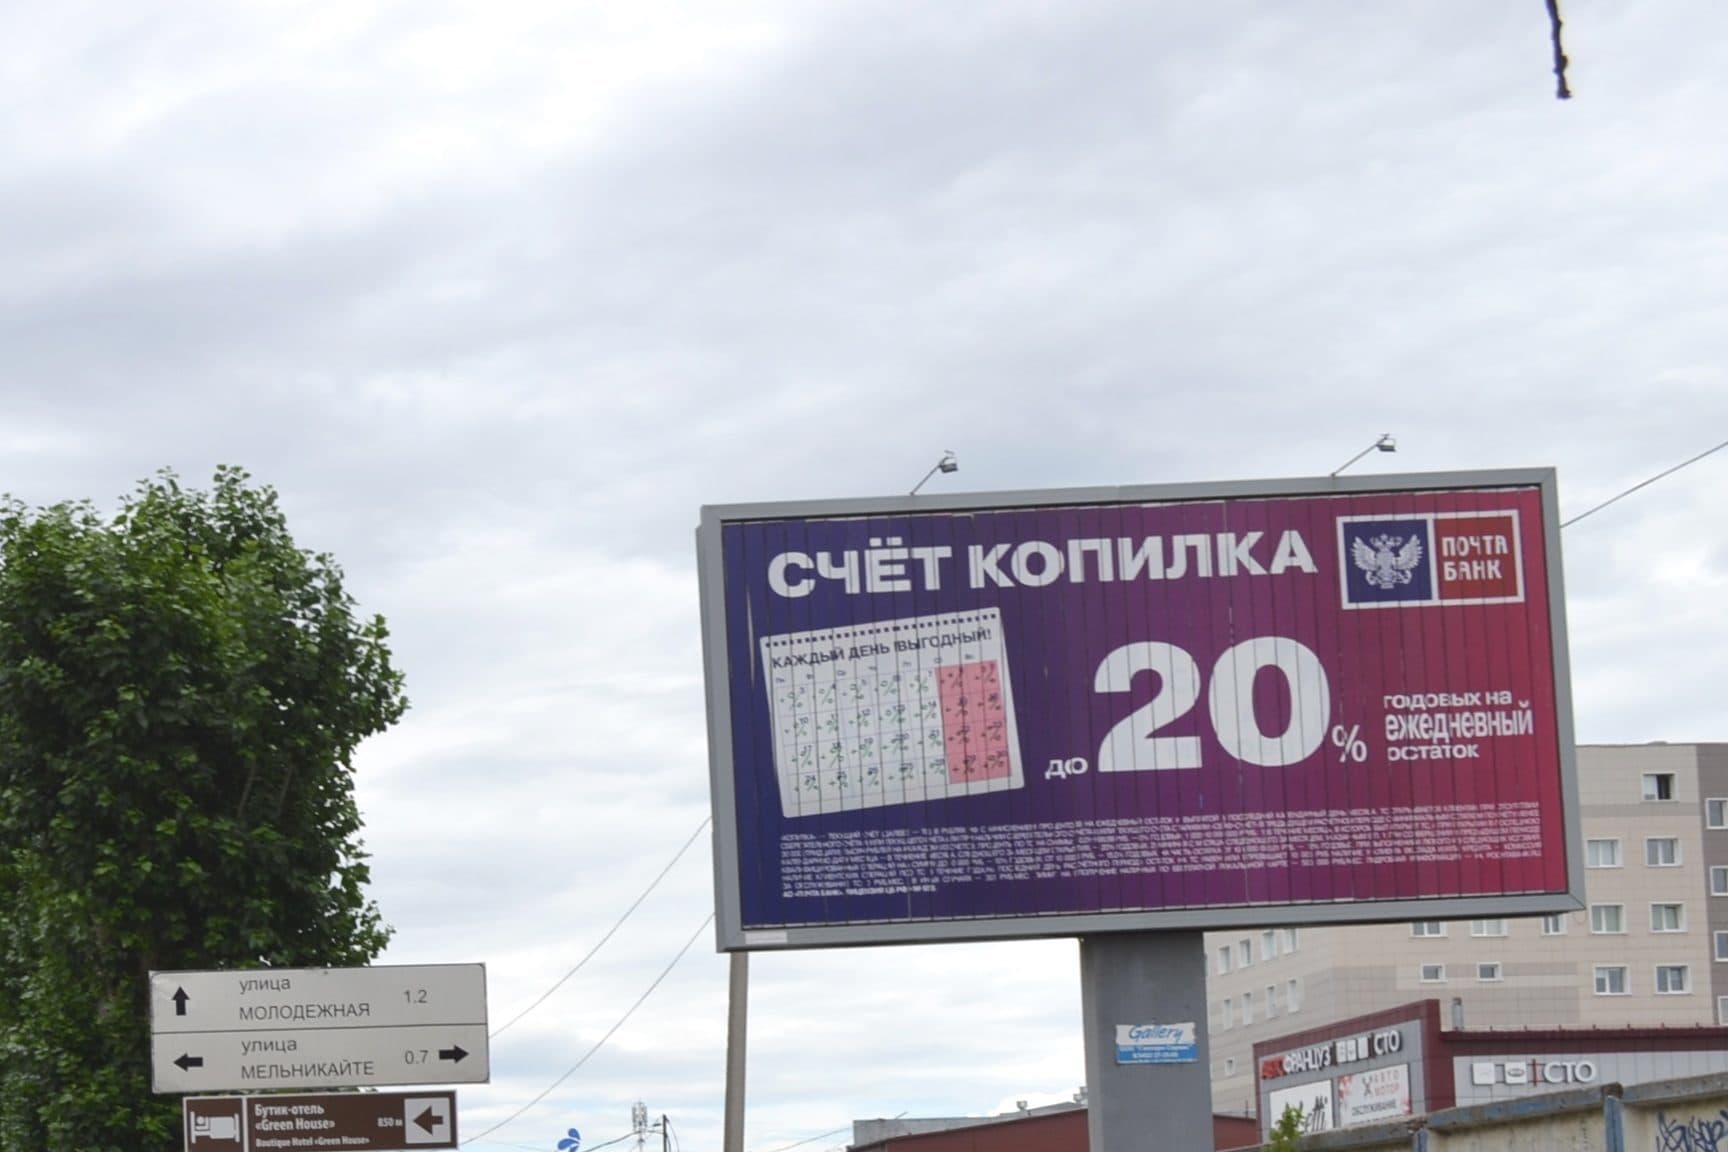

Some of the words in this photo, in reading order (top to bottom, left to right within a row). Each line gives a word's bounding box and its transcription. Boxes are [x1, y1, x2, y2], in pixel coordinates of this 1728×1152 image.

[1441, 535, 1508, 557] ПОЧТА
[768, 536, 952, 598] СЧЁТ
[968, 530, 1318, 590] КОПИЛКА
[1443, 560, 1502, 581] БАНК
[772, 649, 845, 669] КАЖДЫЙ
[848, 643, 890, 660] ДЕНЬ
[894, 628, 992, 653] ВЫГОДНЫЙ!
[1384, 692, 1482, 710] годовых
[1485, 690, 1512, 706] на
[1385, 700, 1534, 743] ежедневный
[1387, 744, 1479, 761] остаток
[1045, 757, 1088, 779] до
[239, 977, 291, 994] улица
[239, 1002, 370, 1022] МОЛОДЕЖНАЯ
[404, 989, 428, 1004] 1.2
[241, 1039, 297, 1056] улица
[1374, 1030, 1401, 1055] СТО
[241, 1060, 375, 1080] МЕЛЬНИКАЙТЕ
[404, 1050, 429, 1065] 0.7
[1543, 1060, 1597, 1083] СТО
[255, 1103, 325, 1118] Бутик-отель
